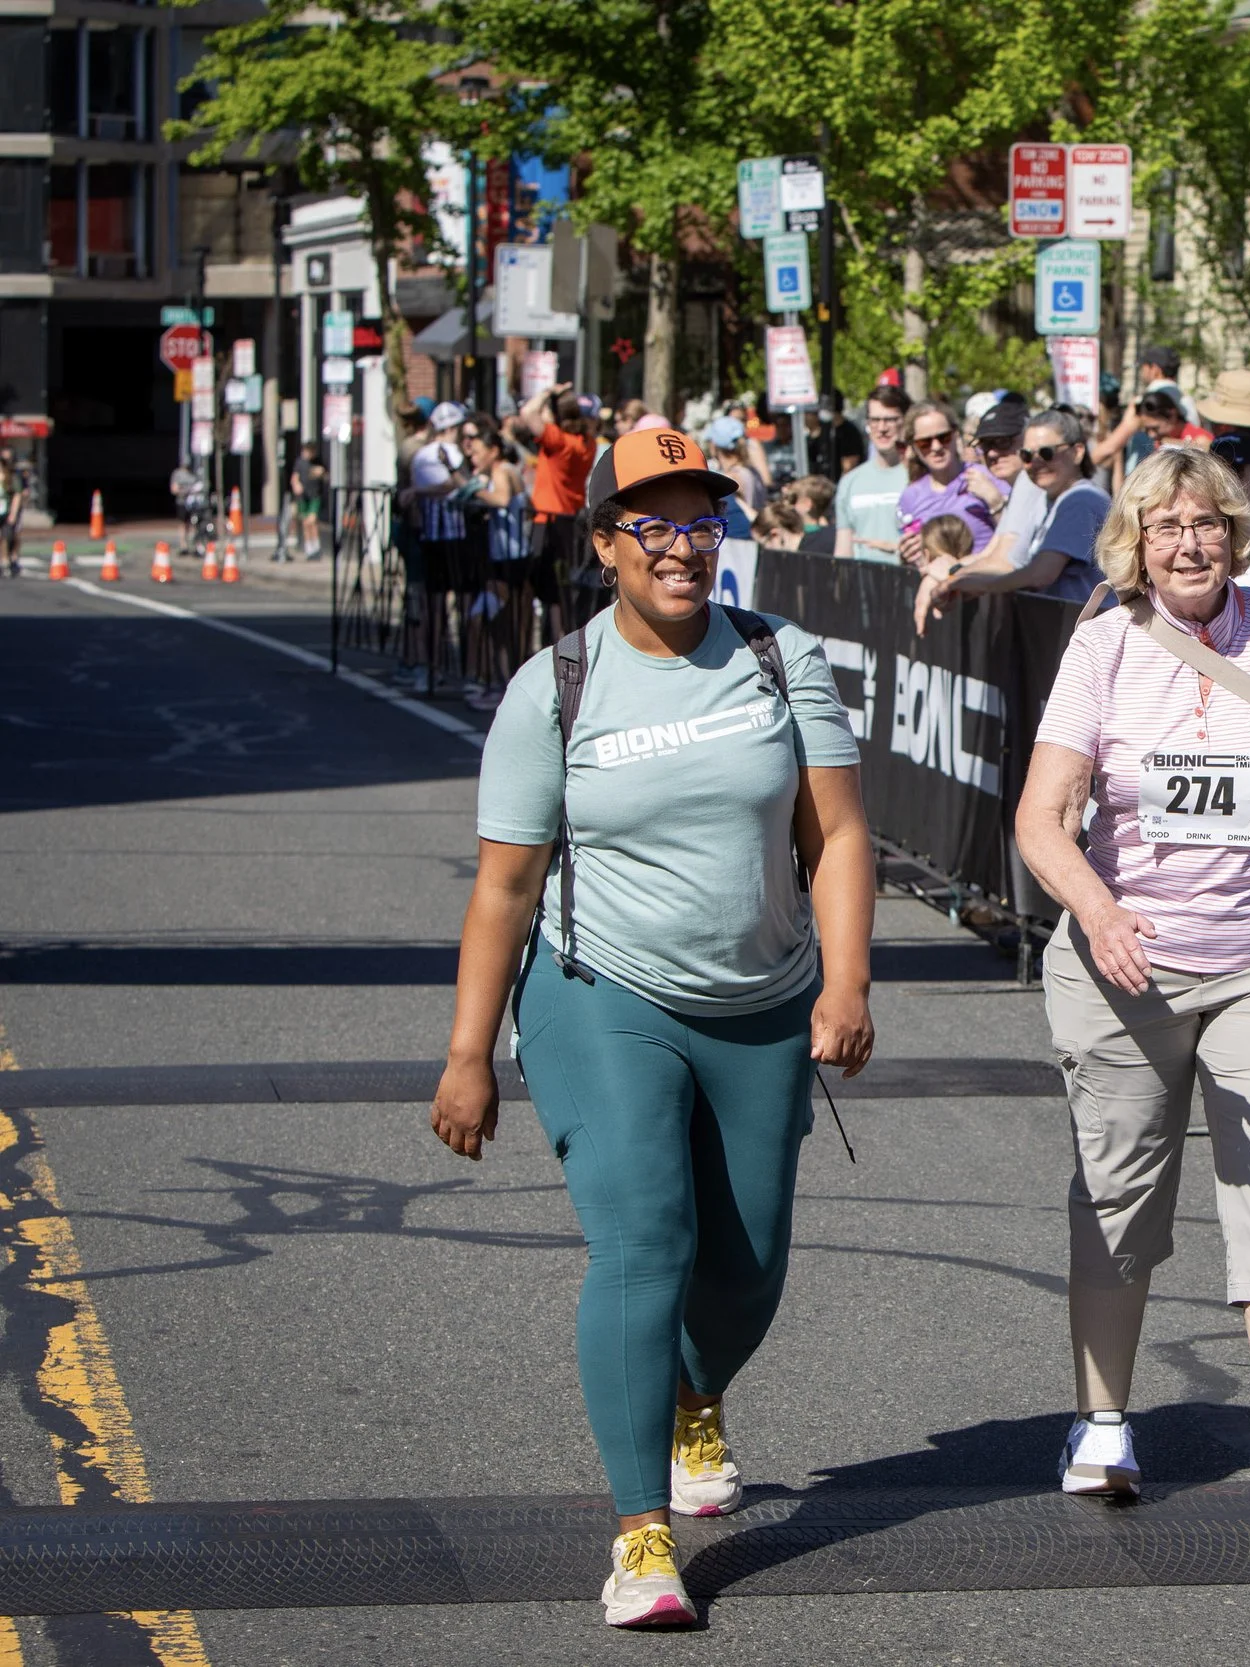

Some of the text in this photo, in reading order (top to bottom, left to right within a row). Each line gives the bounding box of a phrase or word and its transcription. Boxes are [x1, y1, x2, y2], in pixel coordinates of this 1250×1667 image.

[1030, 161, 1048, 174] NO
[1014, 174, 1065, 189] PARKING
[1092, 175, 1106, 185] NO
[1079, 195, 1121, 206] PARKING
[1017, 202, 1060, 217] SNOW
[1045, 264, 1091, 276] PARKING
[594, 706, 752, 764] BIONIC
[1153, 754, 1235, 768] BIONIC
[1165, 775, 1236, 816] 274
[1147, 831, 1170, 839] FOOD
[1186, 832, 1212, 840] DRINK
